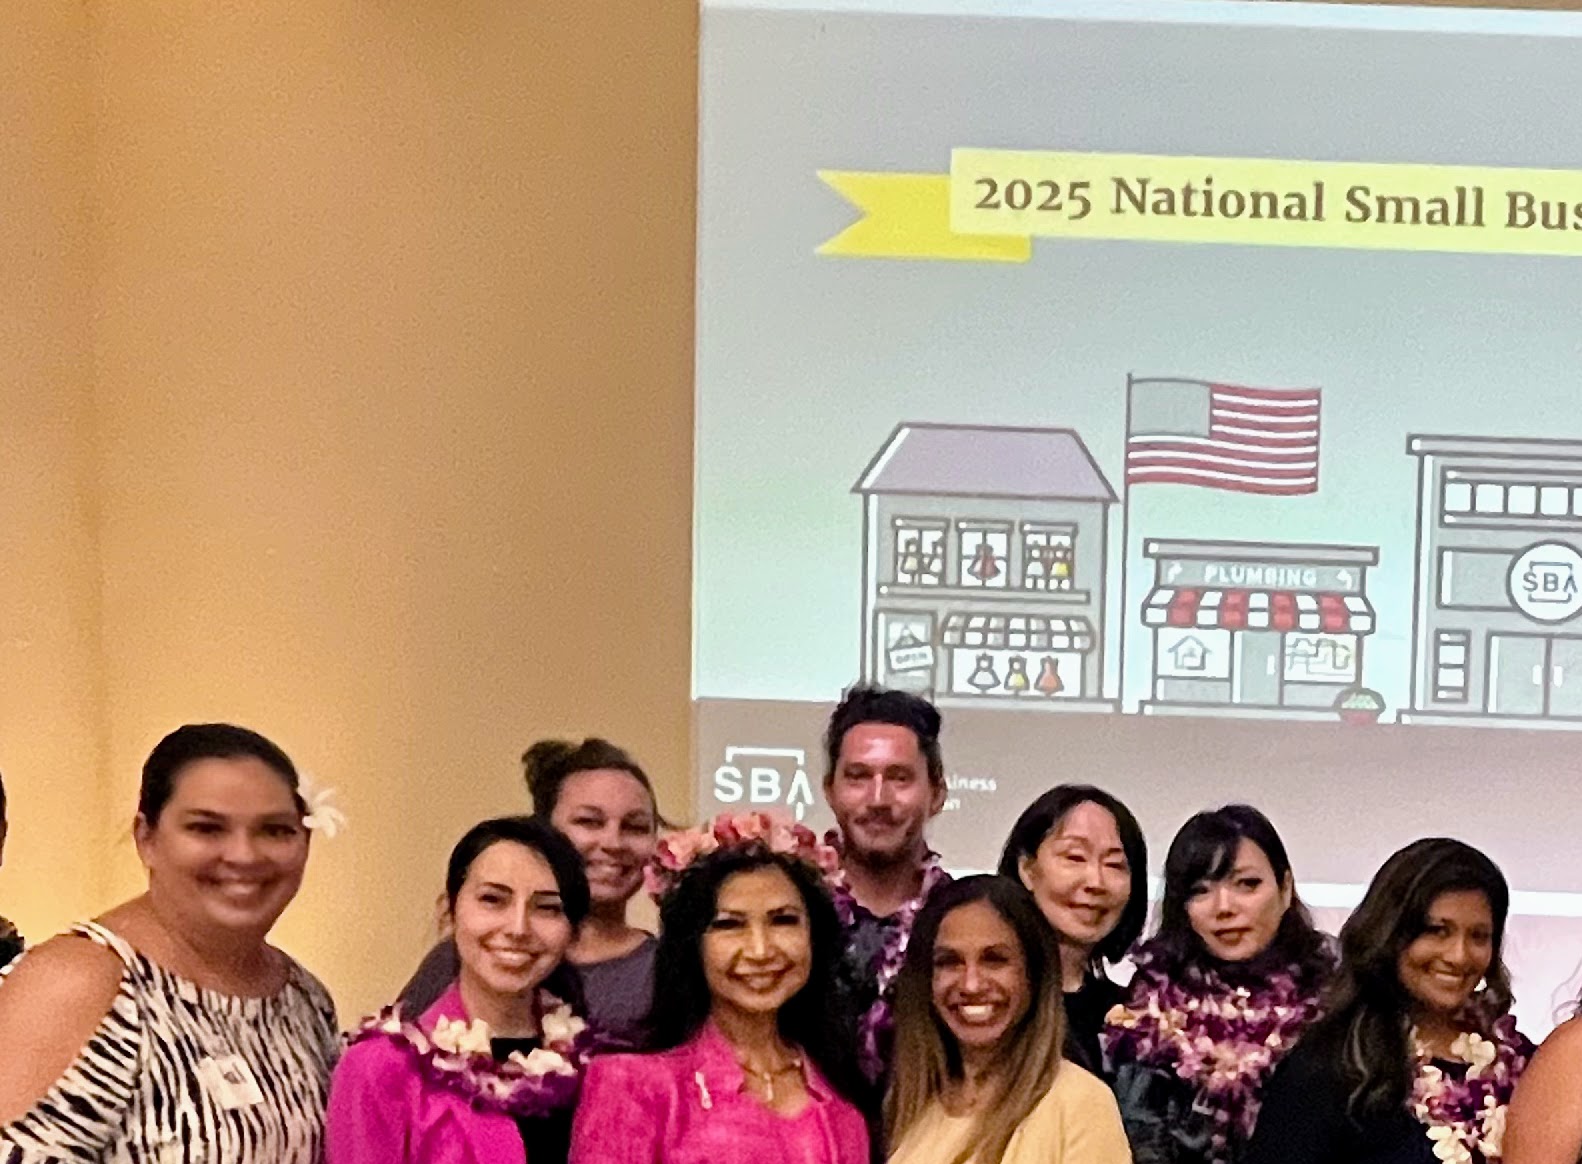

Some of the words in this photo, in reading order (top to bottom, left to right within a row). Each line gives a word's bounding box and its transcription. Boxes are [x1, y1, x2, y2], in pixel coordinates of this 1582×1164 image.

[973, 177, 1093, 220] 2025
[1109, 175, 1326, 222] National
[1344, 184, 1486, 228] Small
[1203, 563, 1318, 587] PLUMBING
[1522, 570, 1579, 594] SBA
[713, 765, 815, 805] SBA
